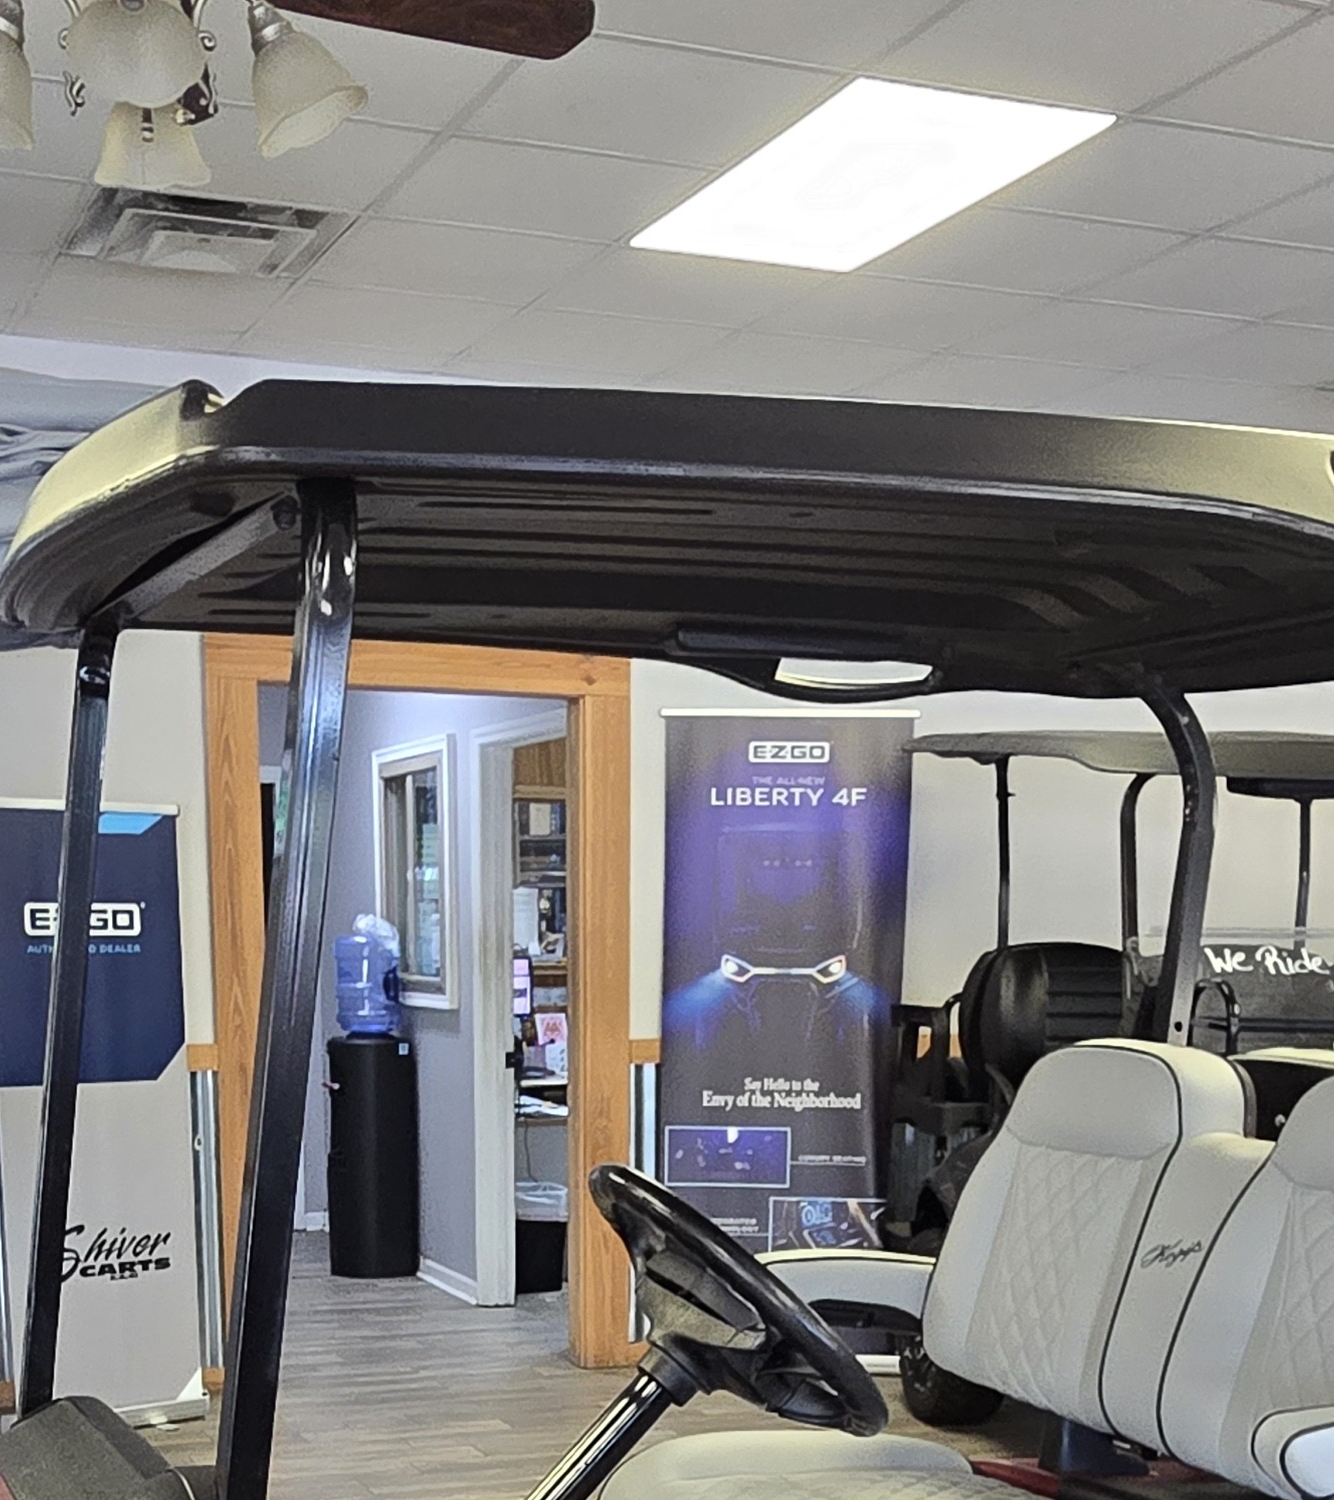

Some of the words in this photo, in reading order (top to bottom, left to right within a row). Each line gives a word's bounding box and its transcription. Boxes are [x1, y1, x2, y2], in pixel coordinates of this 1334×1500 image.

[710, 787, 824, 806] LIBERTY
[832, 787, 868, 806] 4F
[99, 945, 142, 954] DEALER
[1204, 948, 1255, 973] We
[1255, 946, 1331, 976] Ride
[702, 1090, 734, 1112] Envy
[751, 1091, 771, 1107] the
[773, 1092, 862, 1112] Neighborhood
[79, 1257, 171, 1278] CARTS
